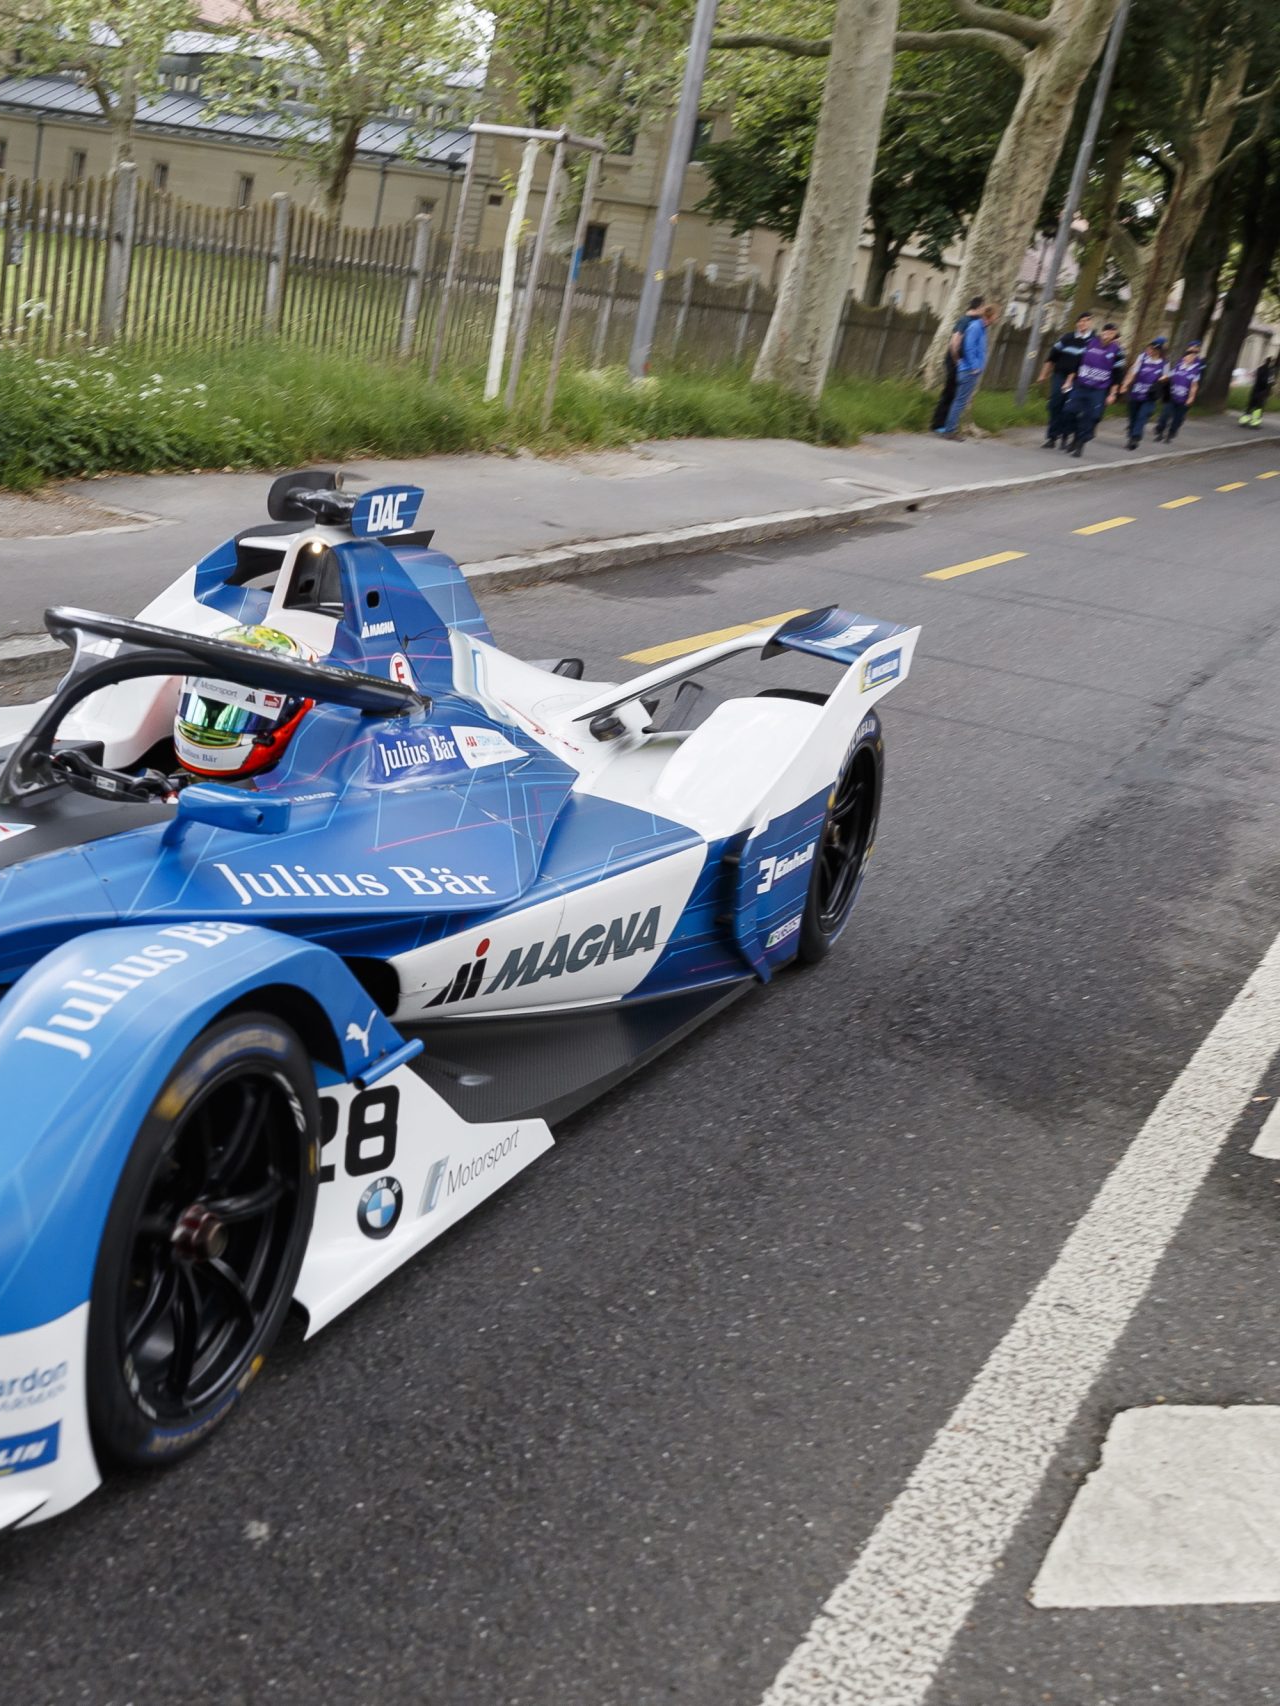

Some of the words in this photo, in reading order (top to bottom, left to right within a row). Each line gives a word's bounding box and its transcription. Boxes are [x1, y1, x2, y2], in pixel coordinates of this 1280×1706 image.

[366, 493, 408, 532] DAC
[201, 680, 238, 698] Motorsport
[378, 737, 430, 777] Julius
[428, 734, 458, 762] Bär
[213, 862, 390, 906] Julius
[387, 865, 497, 896] Bär
[482, 904, 663, 996] MAGNA
[14, 944, 190, 1061] Julius
[446, 1127, 520, 1197] Motorsport
